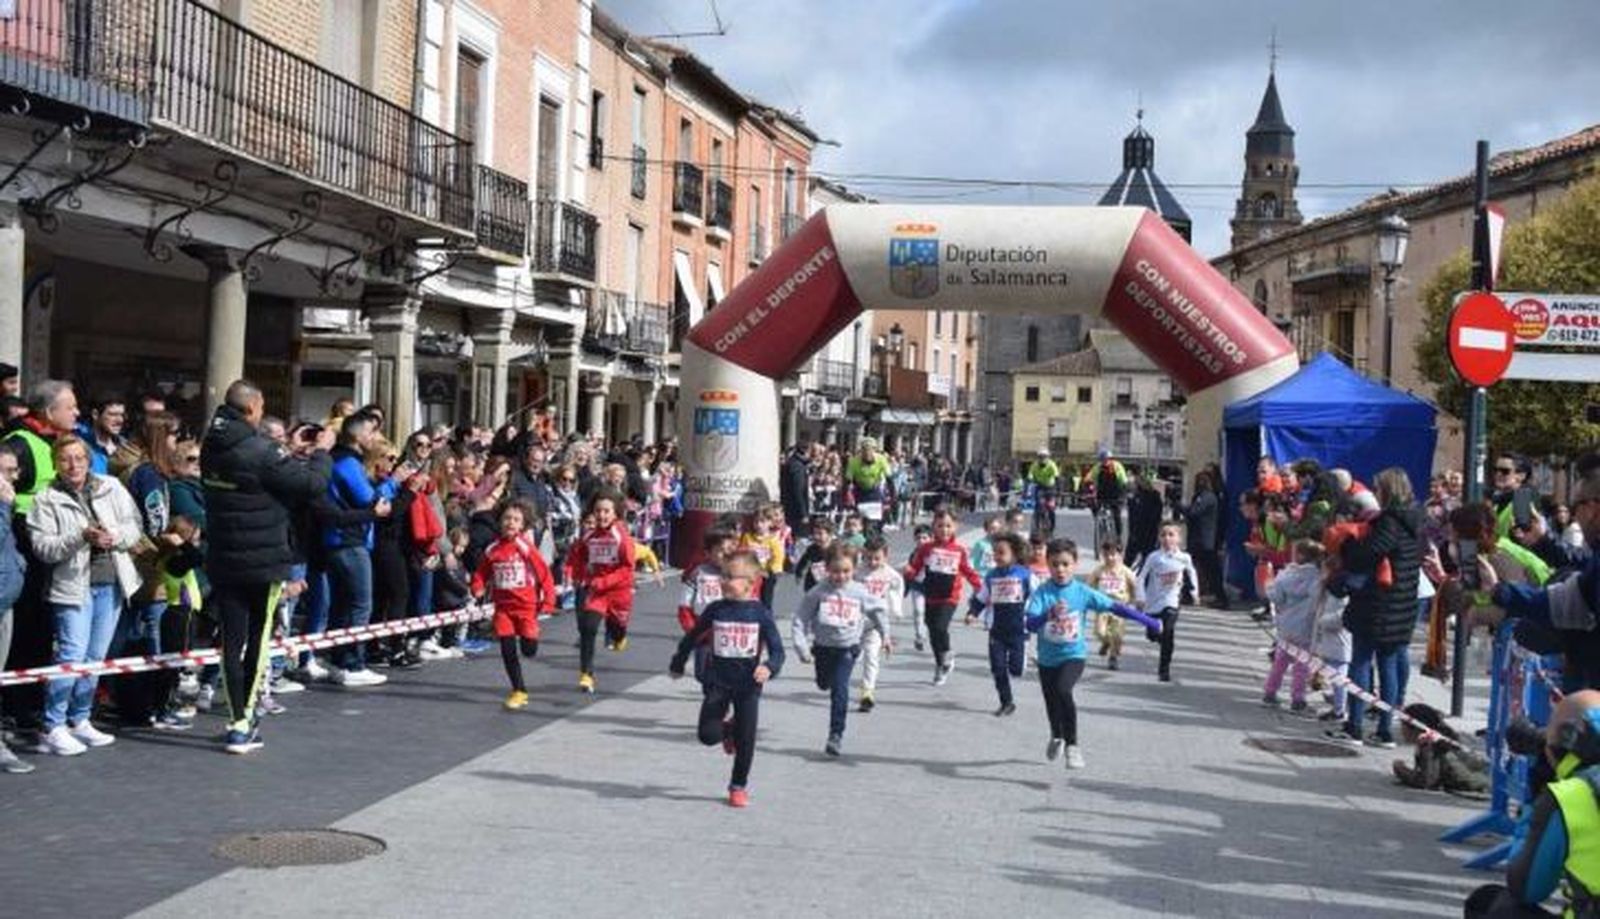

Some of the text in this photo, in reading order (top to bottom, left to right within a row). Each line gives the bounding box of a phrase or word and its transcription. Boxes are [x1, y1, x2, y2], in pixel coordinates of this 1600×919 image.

[715, 246, 835, 353] CON EL DEPORTE
[945, 244, 1048, 266] Diputación
[970, 267, 1067, 287] Salamanca
[1125, 281, 1224, 373] DEPORTISTAS
[1136, 260, 1247, 364] CON NUESTROS
